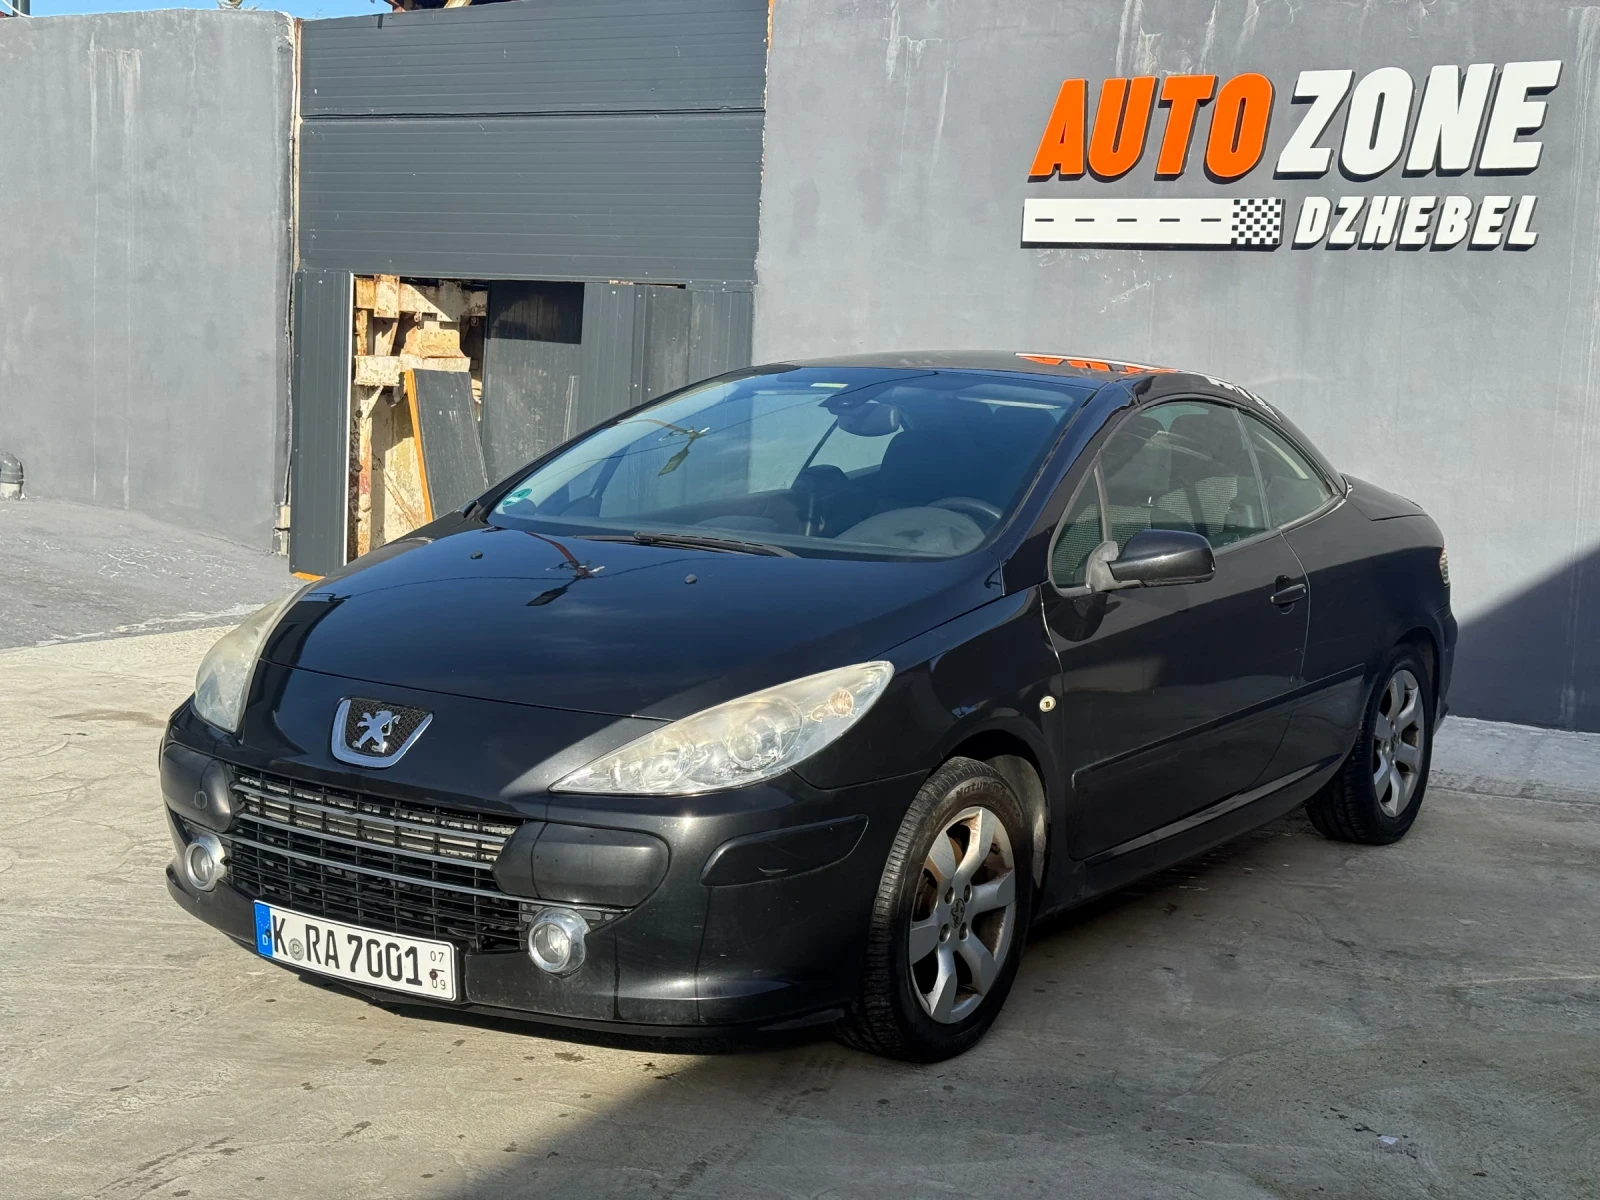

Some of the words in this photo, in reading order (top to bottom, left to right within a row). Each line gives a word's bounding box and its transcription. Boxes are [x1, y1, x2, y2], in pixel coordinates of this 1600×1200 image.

[1028, 72, 1274, 178] AUTO
[1277, 60, 1562, 176] ZONE
[1301, 195, 1538, 246] DZHEBEL
[262, 934, 269, 946] D
[272, 915, 288, 956] K
[305, 923, 340, 969] RA
[347, 933, 423, 987] 7001
[430, 950, 445, 963] 07
